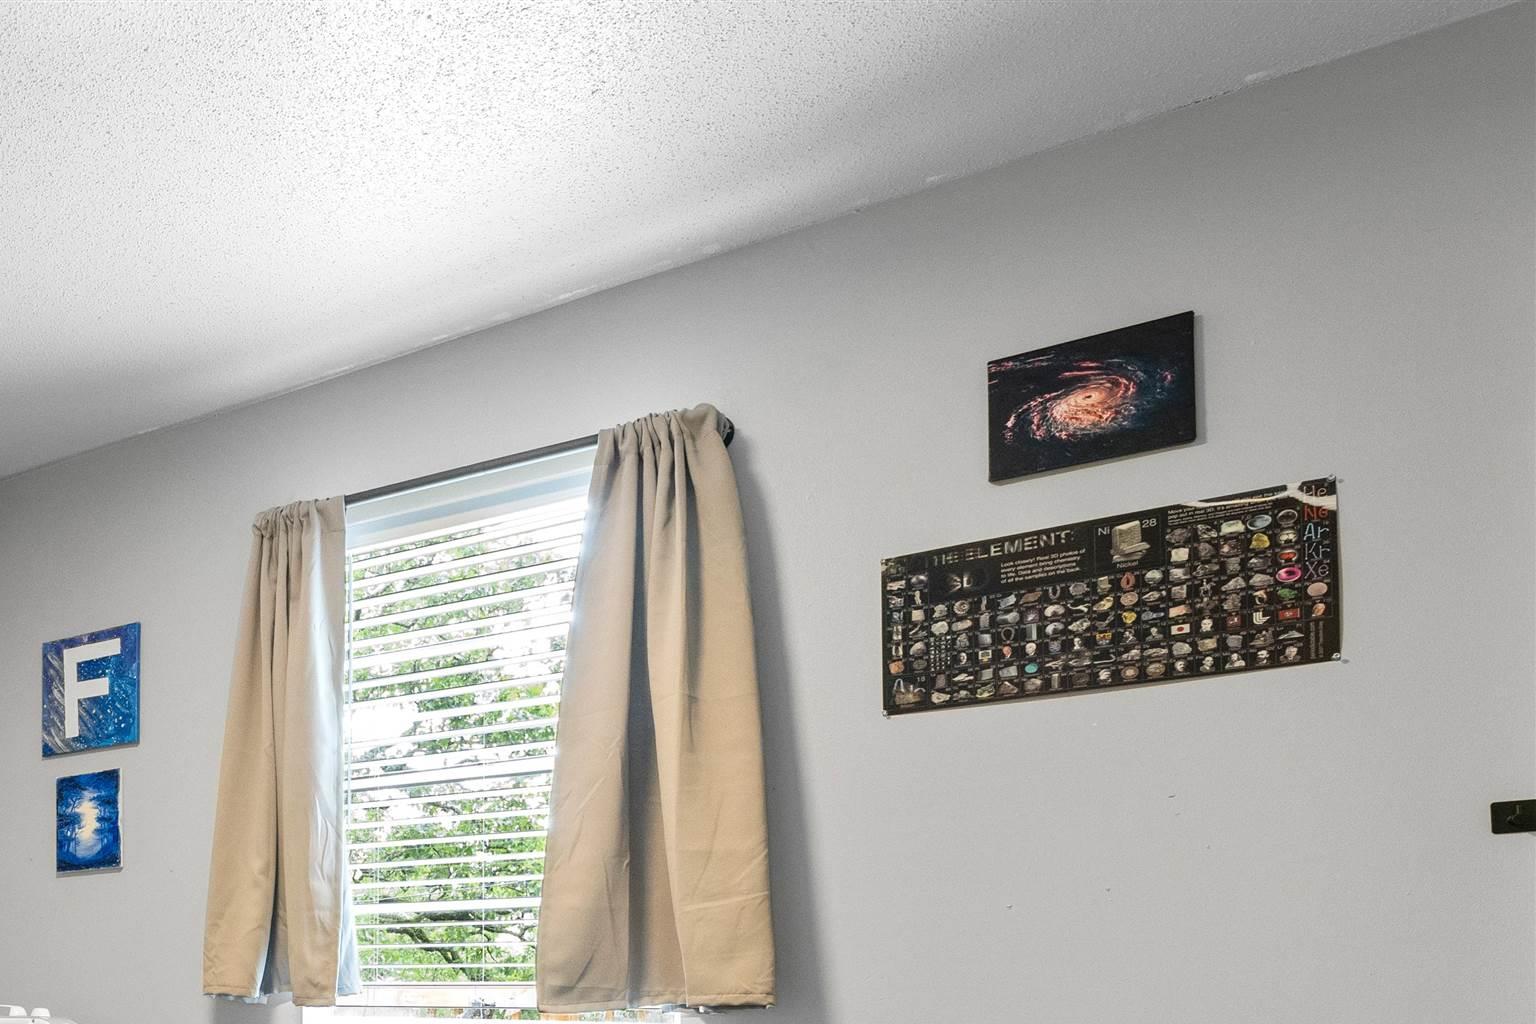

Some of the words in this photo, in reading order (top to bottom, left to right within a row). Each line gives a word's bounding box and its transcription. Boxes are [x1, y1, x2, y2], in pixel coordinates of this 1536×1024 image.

[1098, 526, 1110, 535] Ni
[1142, 518, 1157, 528] 28
[1303, 523, 1329, 541] Ar
[1305, 543, 1330, 561] Kr
[1304, 561, 1329, 579] Xe
[64, 638, 121, 739] F
